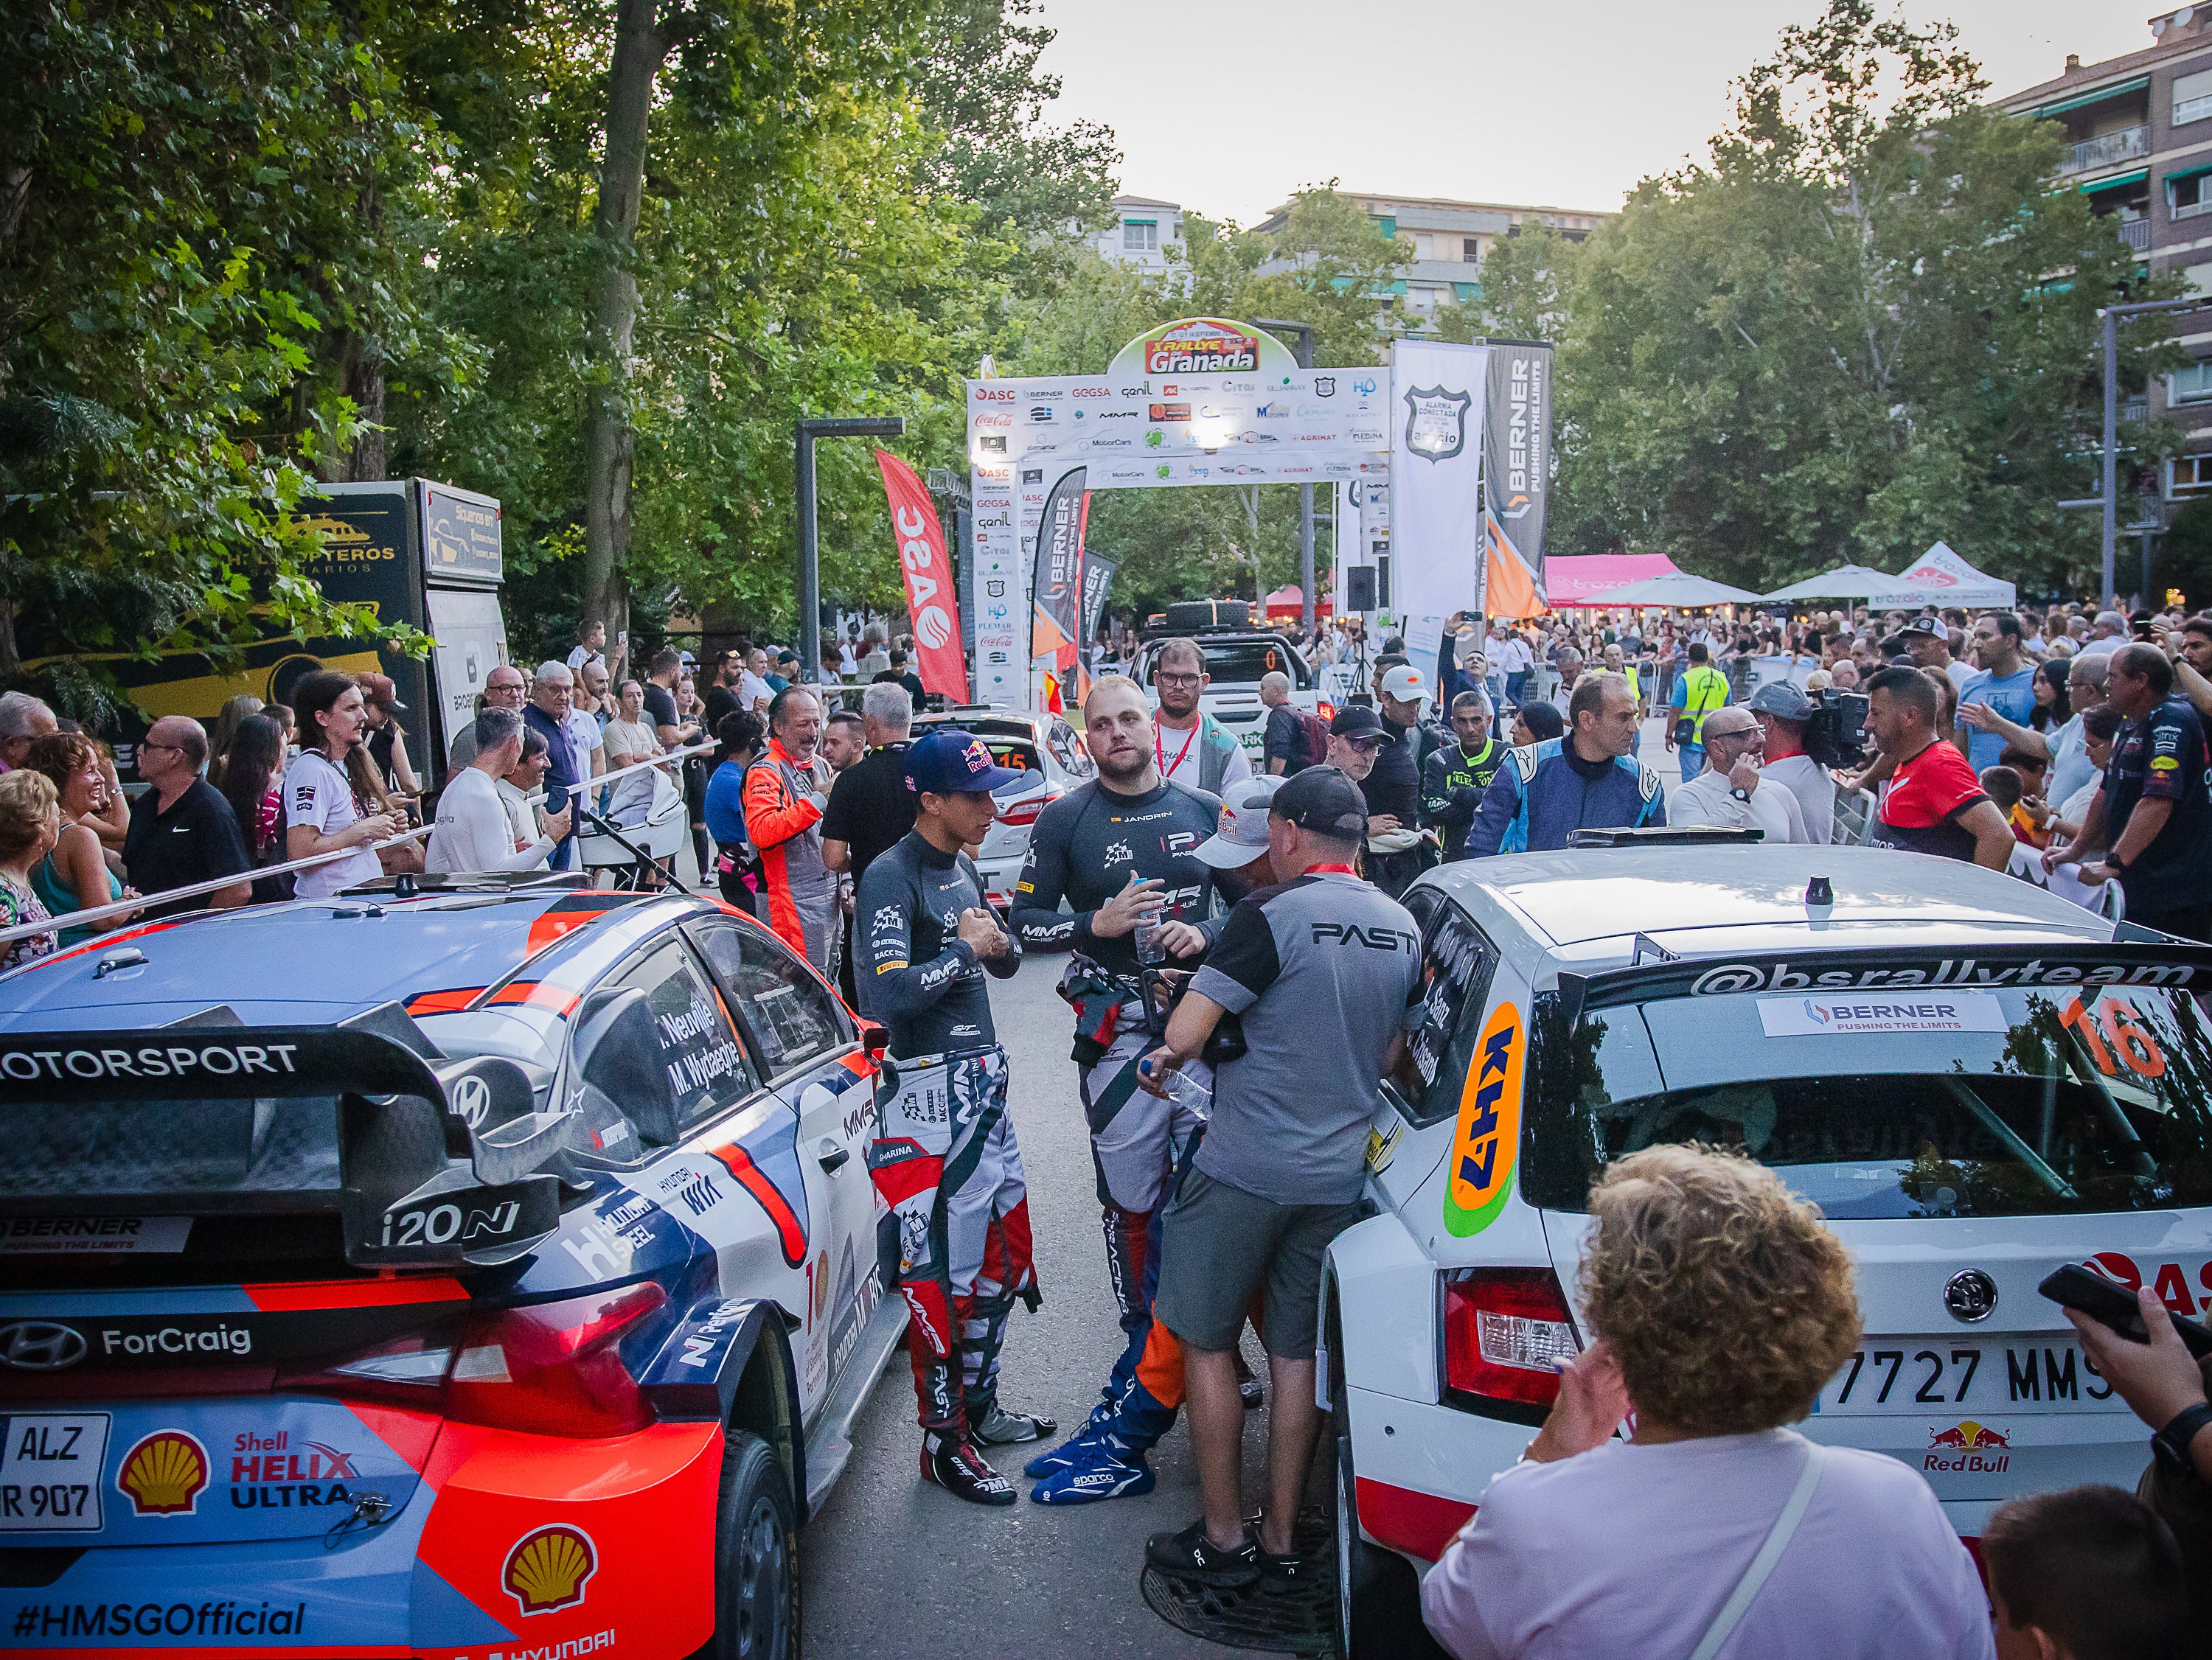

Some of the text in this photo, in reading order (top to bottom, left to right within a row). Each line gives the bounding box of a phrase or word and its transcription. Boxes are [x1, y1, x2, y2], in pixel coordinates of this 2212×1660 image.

[1150, 349, 1254, 373] Granada
[1162, 341, 1221, 351] RALLYE
[988, 390, 1015, 400] ASC
[1121, 380, 1153, 399] genil
[1509, 358, 1528, 492] BERNER
[1531, 360, 1541, 492] PUSHING THE LIMITS
[987, 469, 1009, 477] ASC
[978, 511, 1012, 529] genil
[1051, 497, 1069, 582] BERNER
[968, 758, 987, 773] Red
[999, 753, 1026, 771] 15
[1124, 811, 1172, 823] JANDRIN
[1222, 821, 1237, 834] Bull
[1021, 921, 1075, 937] MMR
[1311, 922, 1415, 955] PAST
[874, 949, 895, 960] RACC
[921, 957, 961, 985] MMR
[1690, 958, 2197, 996] @bsrallyteam
[661, 1000, 716, 1045] Neuville
[1430, 985, 1450, 1030] Sanz
[1833, 1003, 1958, 1020] BERNER
[1837, 1022, 1893, 1031] PUSHING
[1894, 1022, 1918, 1030] THE
[2057, 995, 2166, 1078] 16
[0, 1045, 296, 1081] OTORSPORT
[667, 1038, 740, 1097] M. Wydaeghe
[843, 1098, 878, 1142] MMR
[939, 1103, 947, 1123] RACC
[1458, 1025, 1515, 1191] KH-7
[657, 1167, 694, 1194] HYUNDAI
[10, 1218, 143, 1236] BERNER
[382, 1204, 462, 1246] i20
[592, 1194, 652, 1241] HYUNDAI
[5, 1241, 135, 1250] PUSHING THE LIMITS
[612, 1224, 656, 1260] STEEL
[854, 1263, 884, 1335] MBIS
[102, 1324, 251, 1356] ForCraig
[833, 1319, 858, 1374] HYUNDAI
[934, 1364, 949, 1419] PAST
[1837, 1349, 1981, 1404] 7727
[16, 1426, 83, 1462] ALZ
[234, 1430, 288, 1453] Shell
[230, 1445, 358, 1483] HELIX
[1923, 1454, 2011, 1474] Red Bull
[230, 1483, 349, 1510] ULTRA
[1073, 1473, 1114, 1488] sparco
[31, 1485, 90, 1518] 907
[13, 1603, 306, 1639] #HMSGOfficial
[511, 1628, 616, 1660] HYUNDAI
